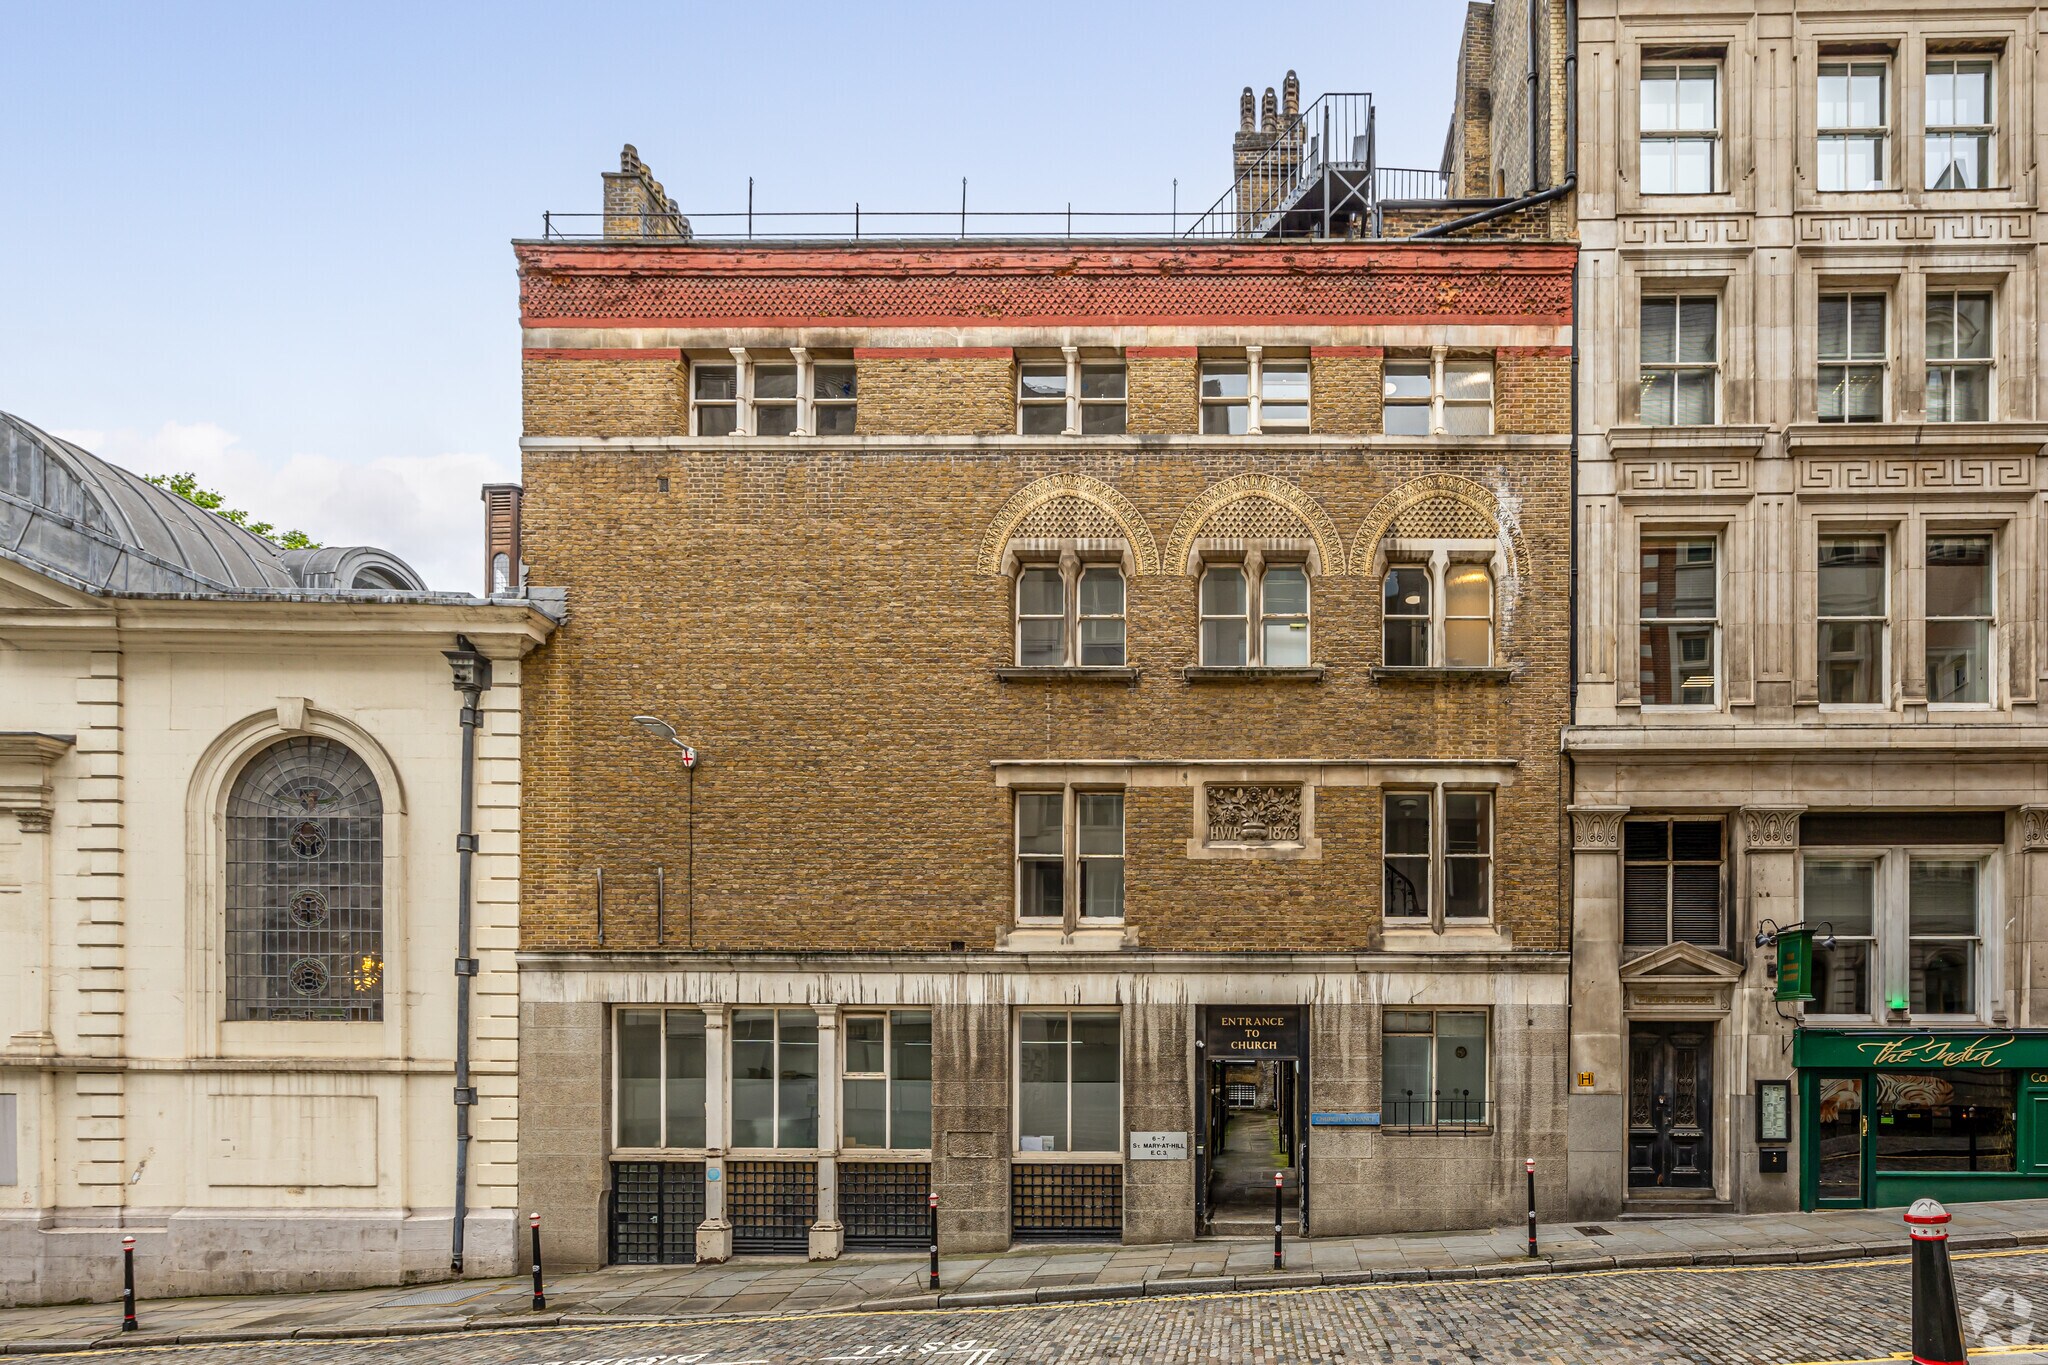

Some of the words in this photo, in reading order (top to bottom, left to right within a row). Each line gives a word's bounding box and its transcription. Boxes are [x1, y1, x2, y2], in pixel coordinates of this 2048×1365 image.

[1210, 826, 1240, 840] HWP
[1268, 826, 1298, 840] 1873
[1221, 1017, 1284, 1026] ENTRANCE
[1244, 1029, 1260, 1038] TO
[1230, 1041, 1277, 1050] CHURCH
[1857, 1035, 1935, 1065] The
[1581, 1073, 1591, 1085] H
